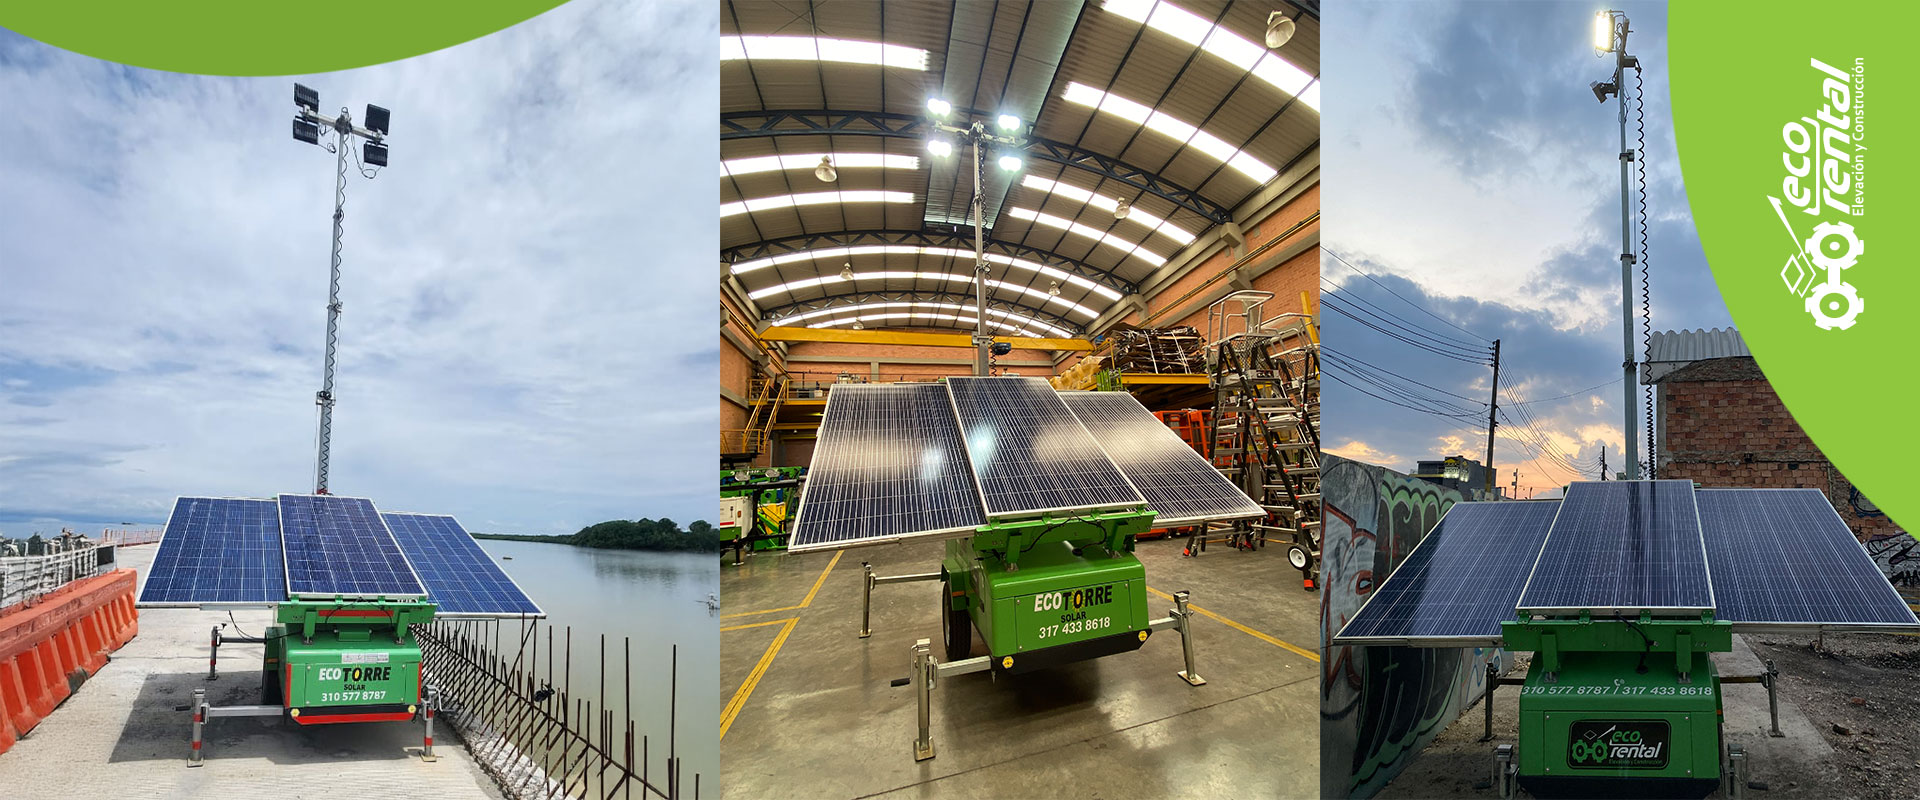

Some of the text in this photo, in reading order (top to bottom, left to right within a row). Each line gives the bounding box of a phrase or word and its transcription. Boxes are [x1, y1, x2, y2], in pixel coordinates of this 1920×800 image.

[1060, 611, 1087, 624] SOLAR
[1038, 616, 1111, 639] 317 433 8618
[343, 683, 366, 691] SOLAR
[1521, 686, 1546, 695] 310
[1548, 686, 1574, 695] 577
[1576, 686, 1610, 695] 8787
[1622, 686, 1646, 695] 317
[1649, 686, 1675, 695] 433
[1679, 686, 1712, 695] 8618
[321, 690, 387, 702] 310 577 8787
[1611, 730, 1641, 743] eco
[1609, 741, 1663, 759] rental
